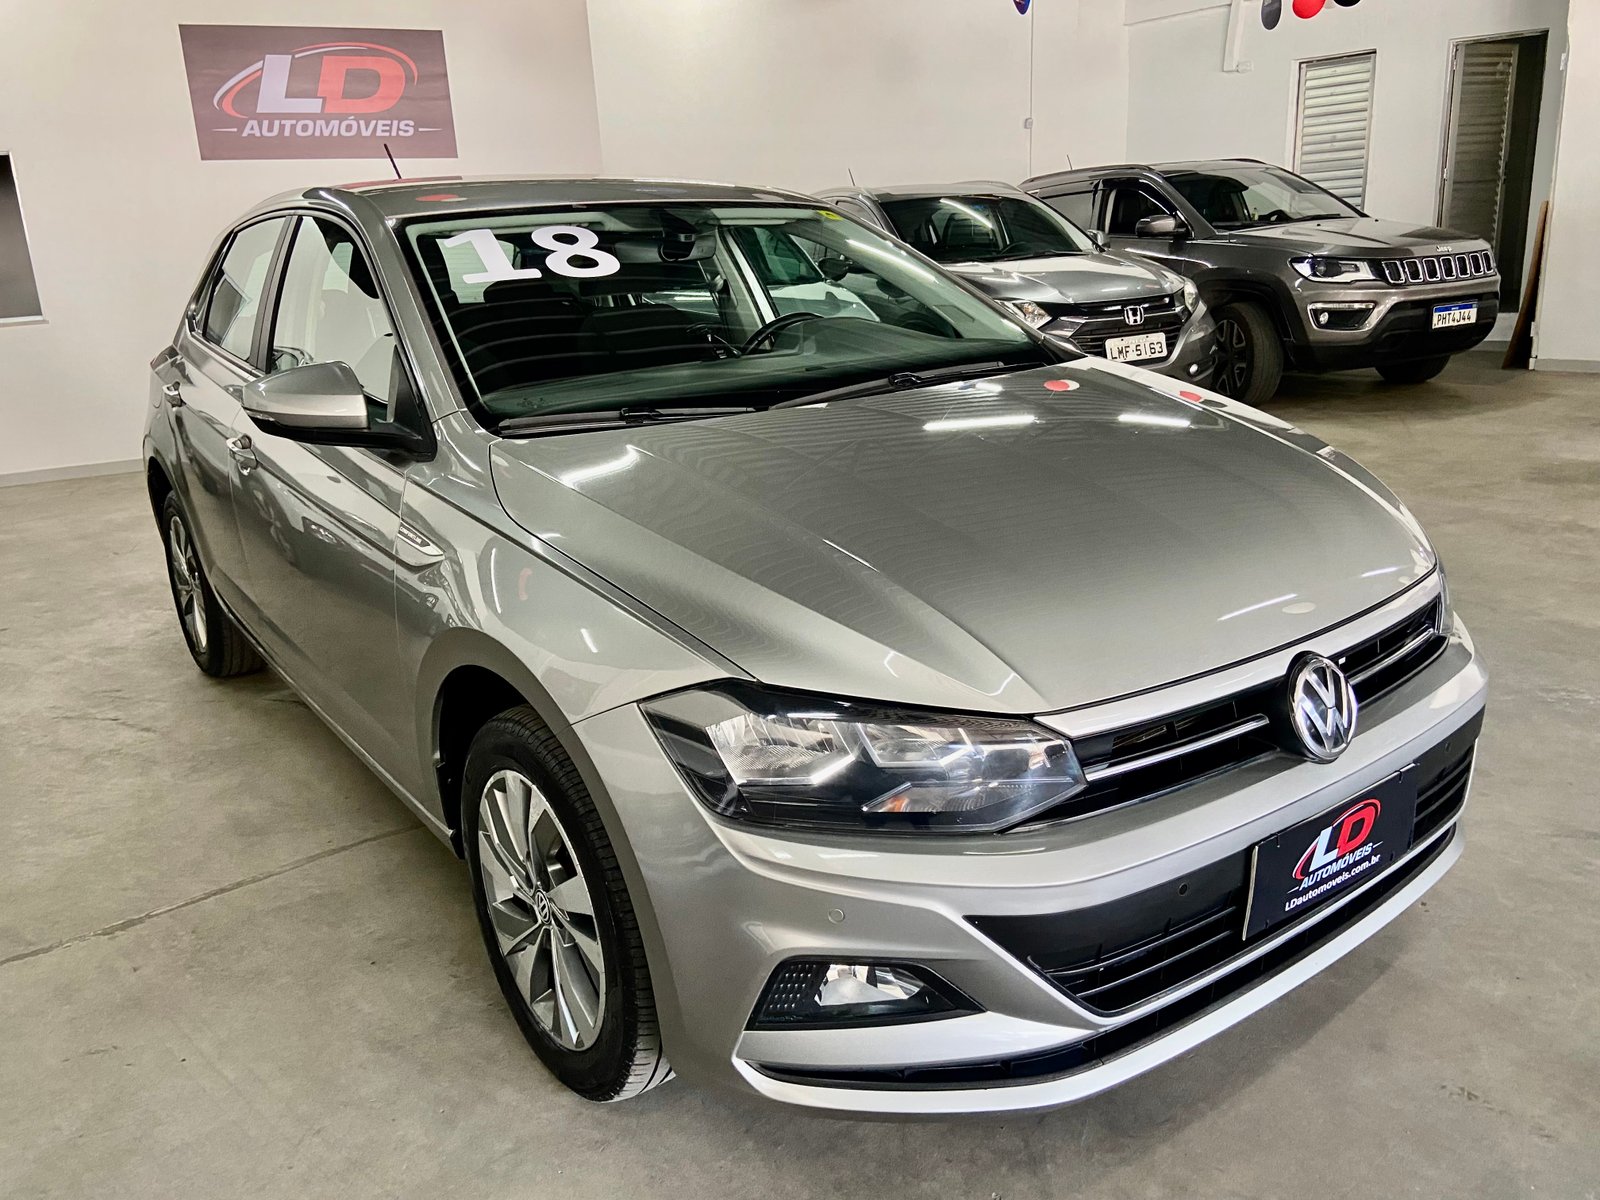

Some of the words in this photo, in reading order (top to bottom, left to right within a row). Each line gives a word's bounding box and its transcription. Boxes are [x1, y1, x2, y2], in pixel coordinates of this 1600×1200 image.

[256, 54, 406, 114] LD
[242, 116, 415, 137] AUTOMÓVEIS
[443, 225, 621, 284] 18
[1436, 310, 1472, 326] PHT4J44
[1299, 842, 1374, 891] AUTOMÓVEIS
[1309, 805, 1376, 872] LD
[1285, 854, 1381, 911] LDautomoveis.com.br
